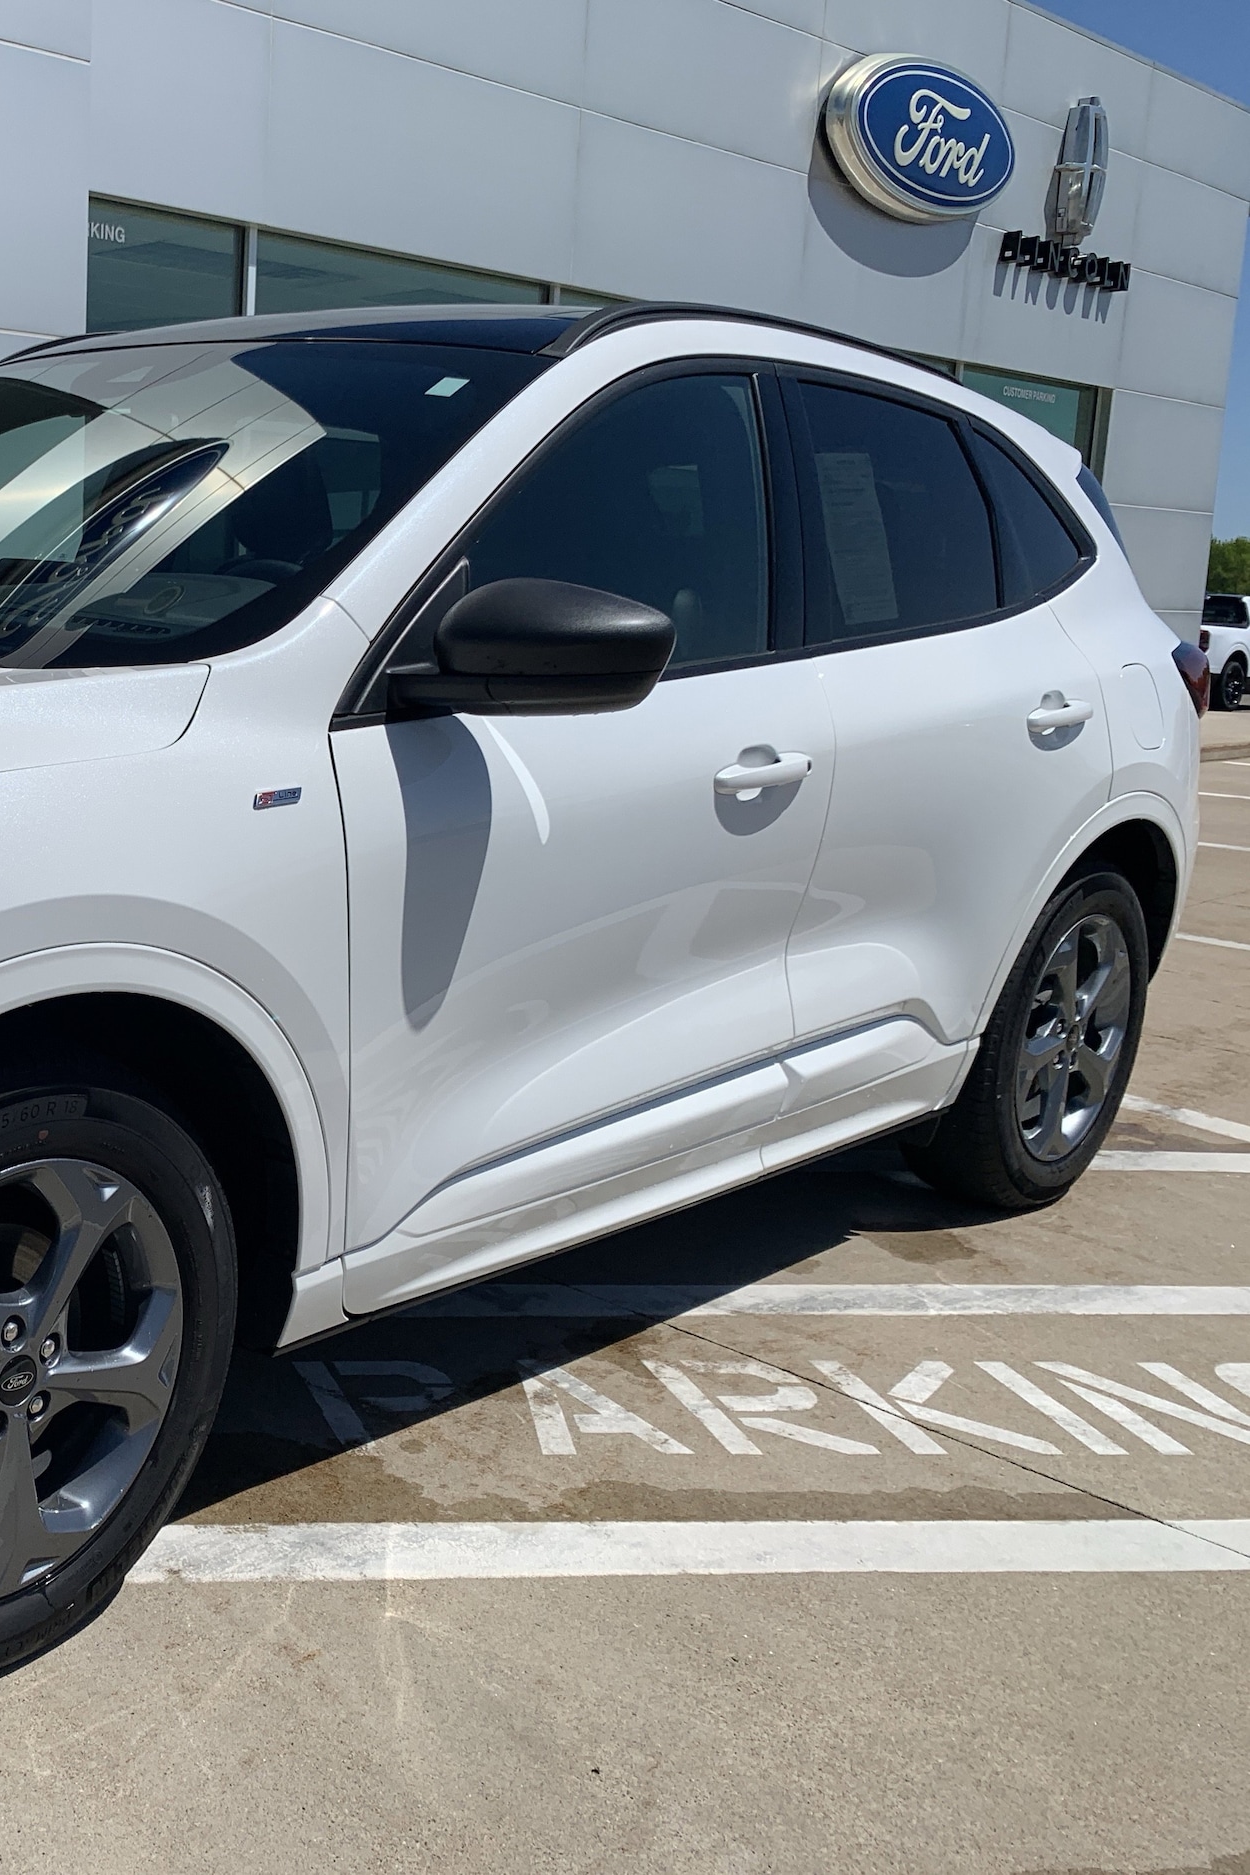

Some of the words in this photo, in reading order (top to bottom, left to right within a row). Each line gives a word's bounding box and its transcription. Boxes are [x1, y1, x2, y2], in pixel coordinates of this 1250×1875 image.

[894, 88, 991, 188] Ford
[88, 221, 126, 244] KING
[1000, 230, 1132, 292] LINCOLN
[1003, 385, 1032, 400] CUSTOMER
[291, 1359, 1250, 1456] PARKIN
